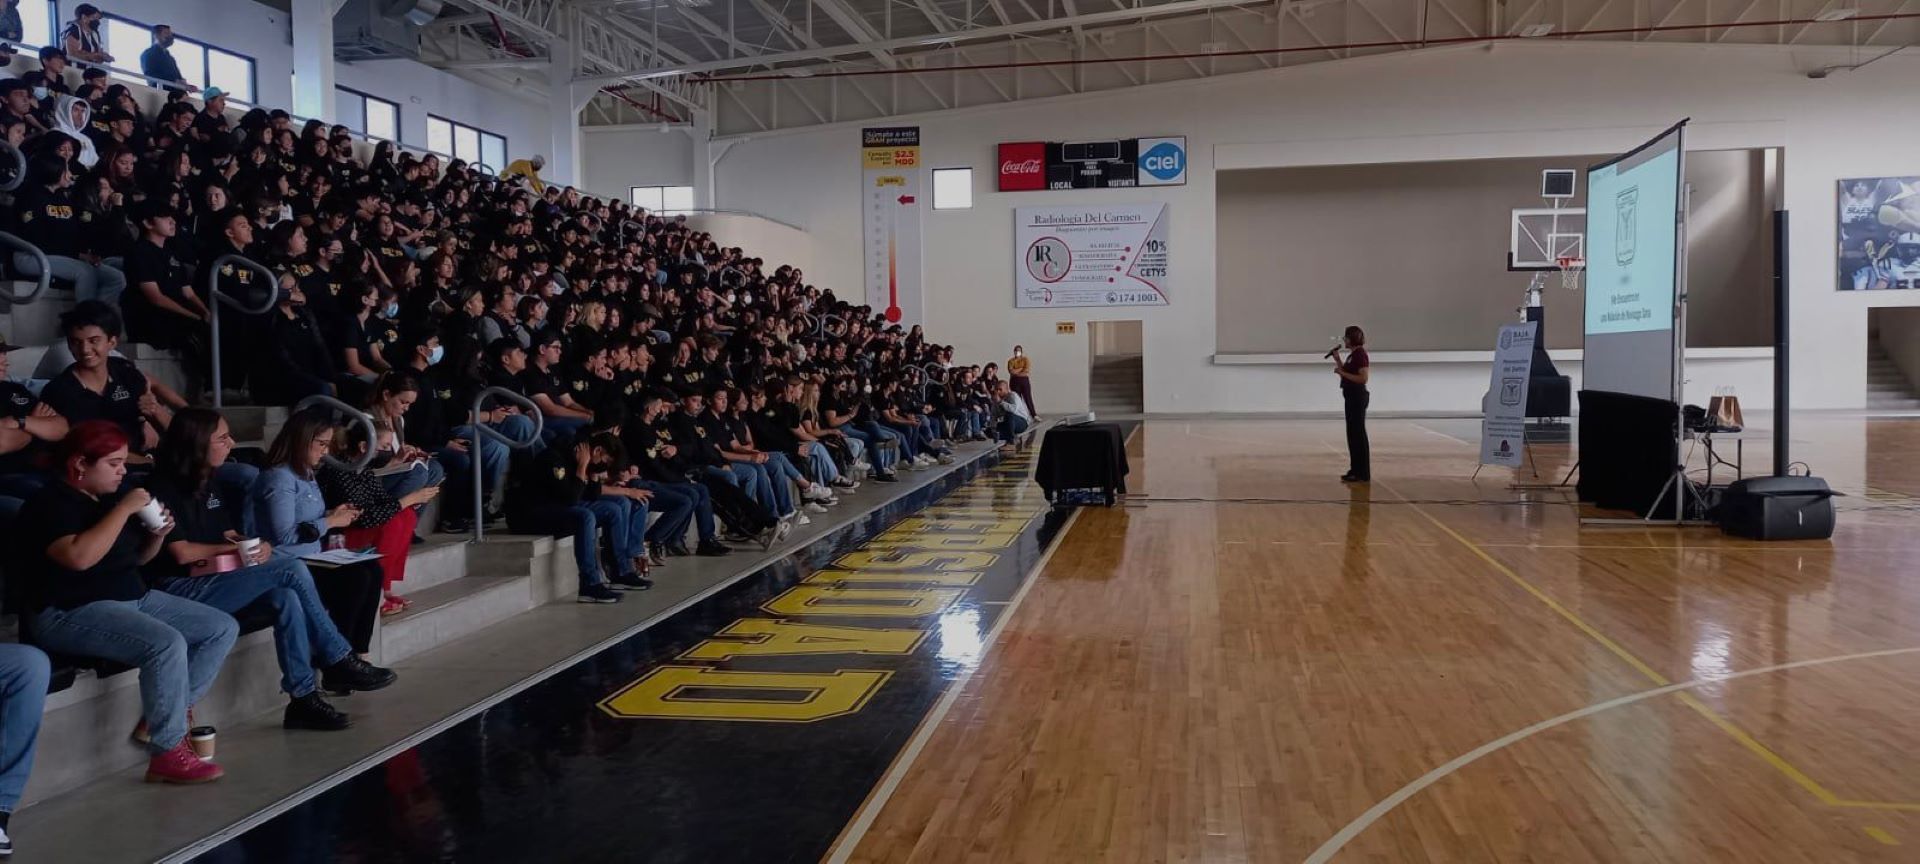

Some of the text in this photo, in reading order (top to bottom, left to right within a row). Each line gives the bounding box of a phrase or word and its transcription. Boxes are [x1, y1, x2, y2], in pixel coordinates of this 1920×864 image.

[1145, 152, 1179, 171] ciel
[1050, 181, 1073, 190] LOCAL
[1108, 178, 1136, 188] VISITANTE
[1085, 212, 1101, 223] Del
[1104, 212, 1141, 223] Carmen
[1146, 240, 1167, 253] 10%
[1140, 268, 1167, 277] CETYS
[1119, 292, 1158, 303] 174 1003
